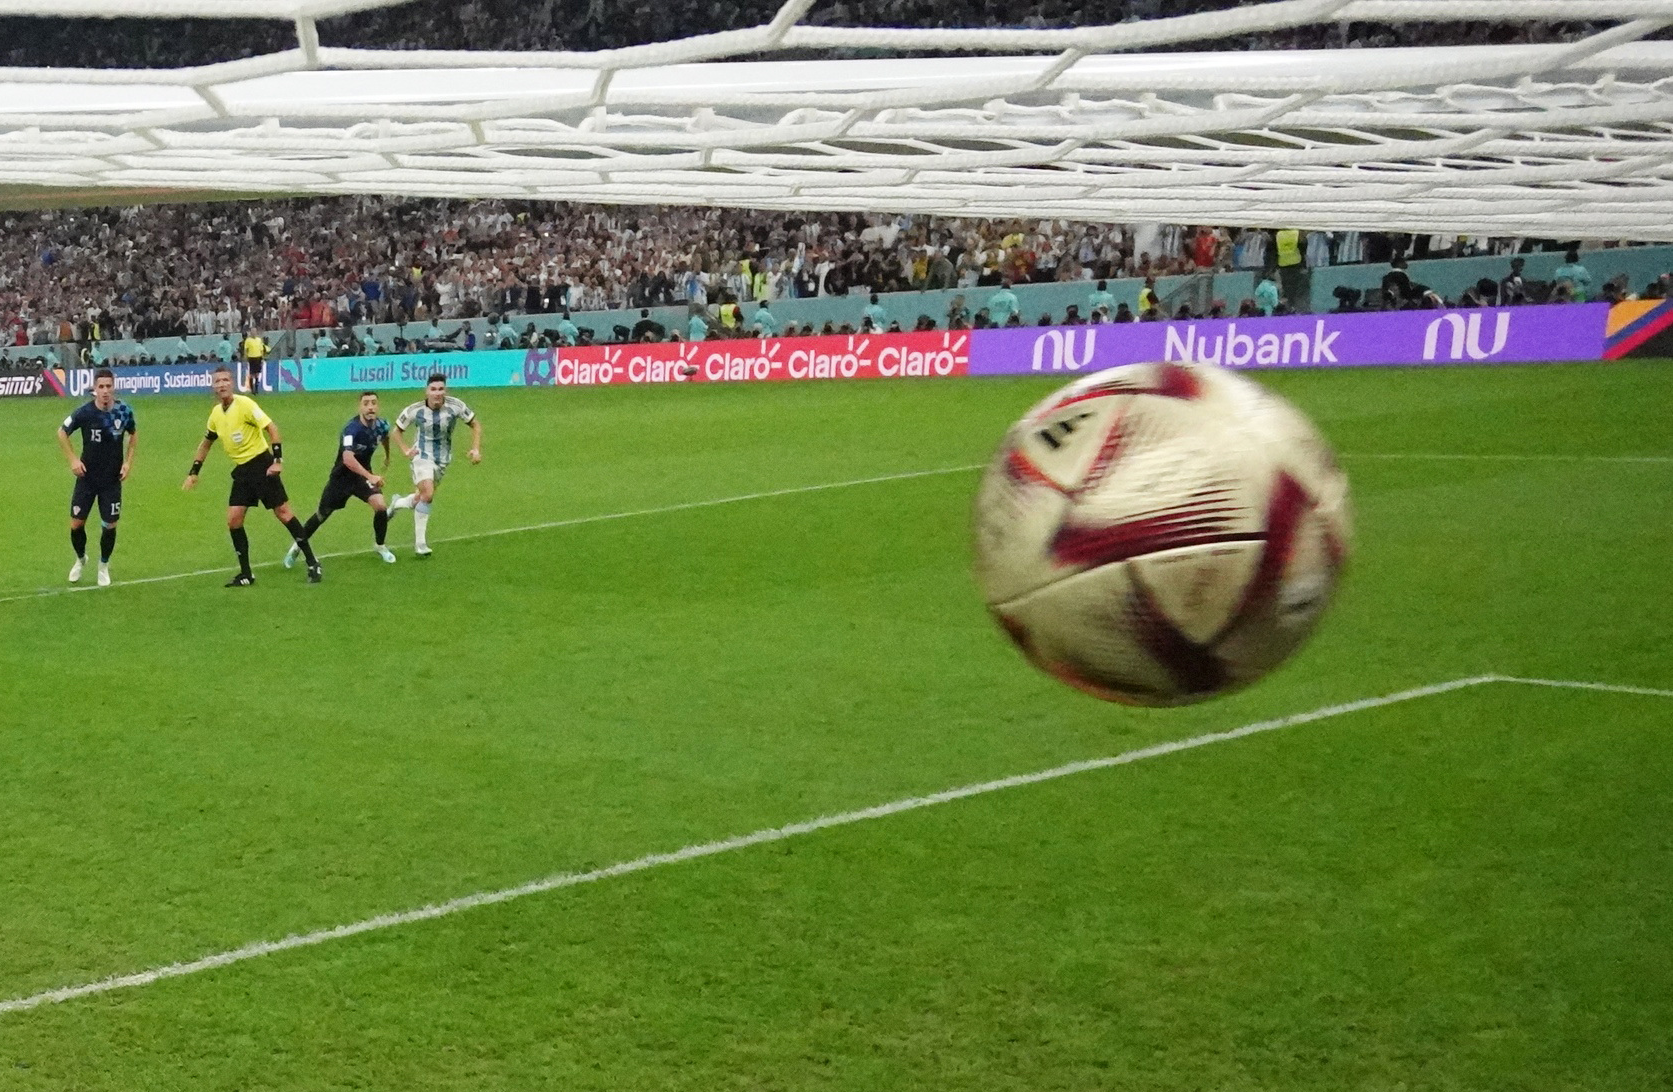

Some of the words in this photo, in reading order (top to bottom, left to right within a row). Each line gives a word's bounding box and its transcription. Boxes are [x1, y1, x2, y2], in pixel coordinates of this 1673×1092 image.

[1164, 319, 1344, 365] Nubank
[114, 372, 160, 394] imagining
[164, 370, 213, 388] Sustainab
[350, 361, 394, 382] Lusail
[90, 429, 102, 442] 15
[110, 502, 121, 516] 15
